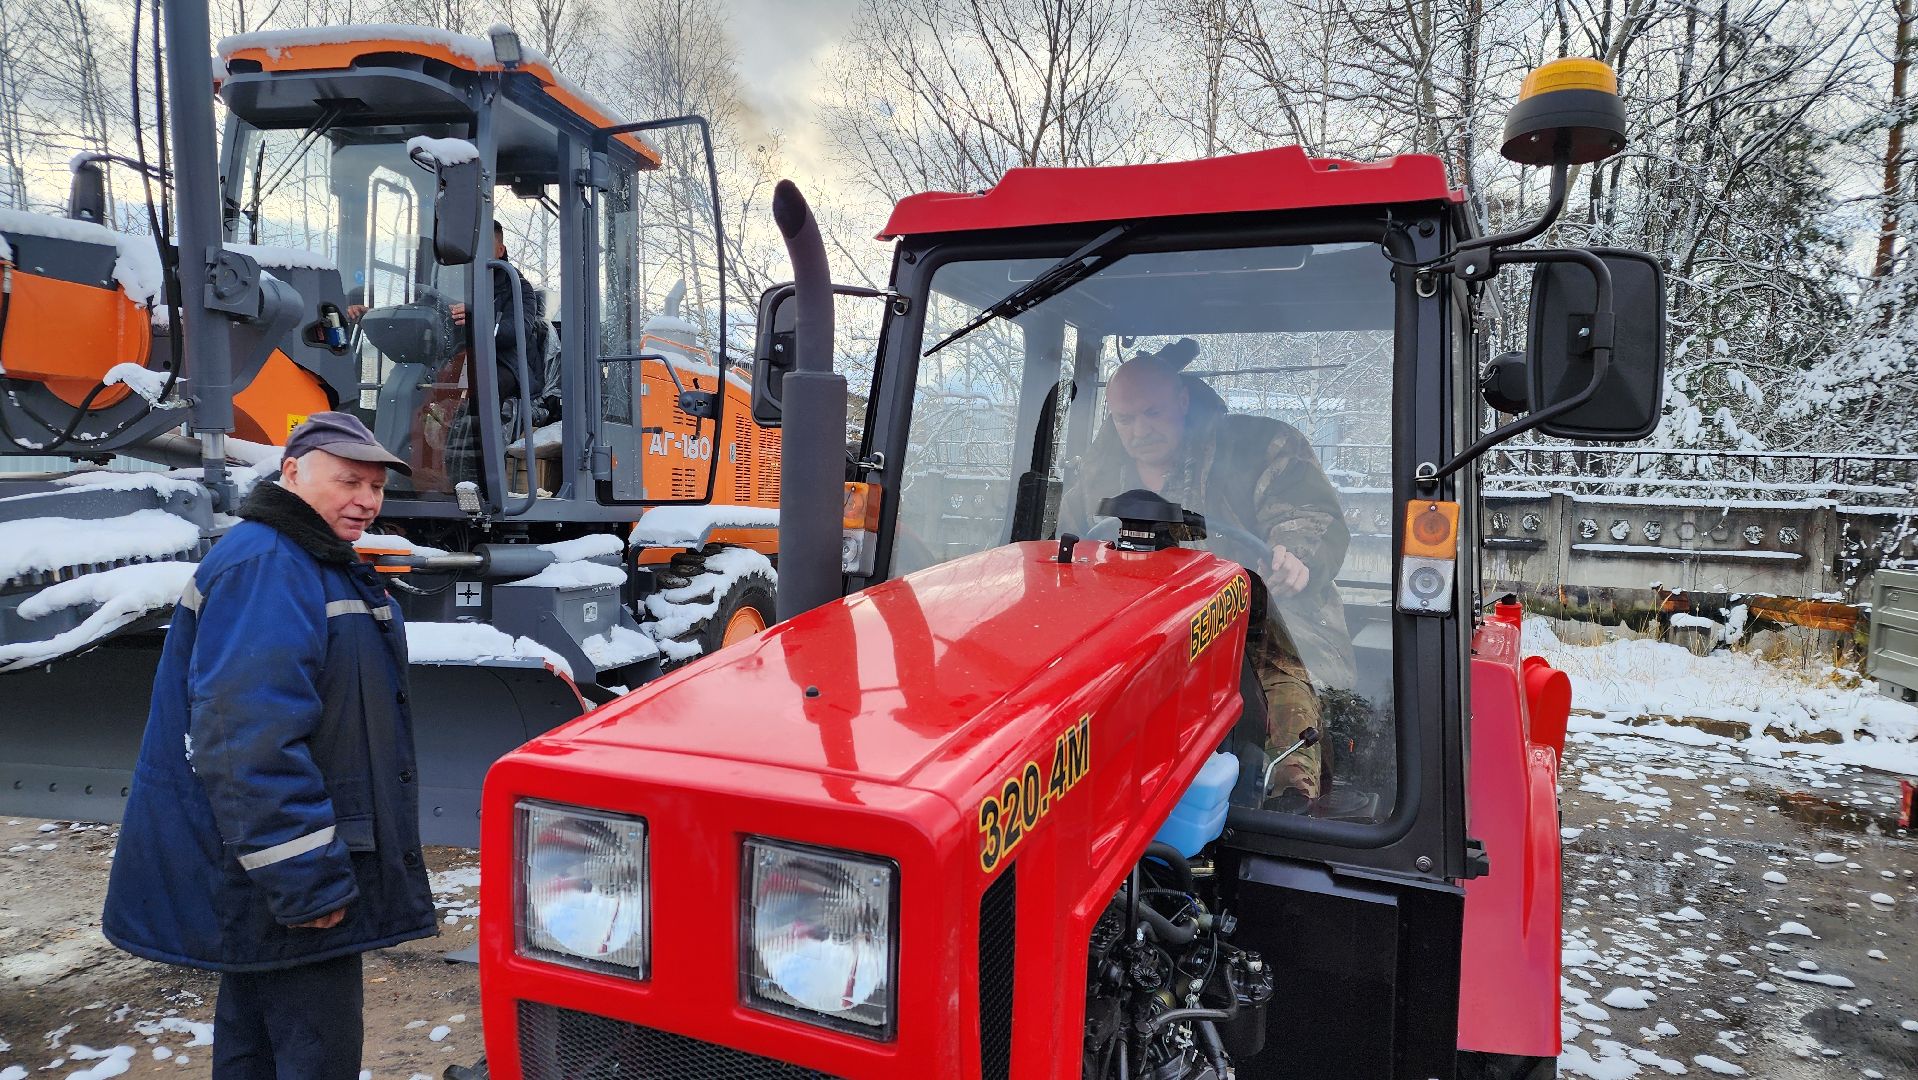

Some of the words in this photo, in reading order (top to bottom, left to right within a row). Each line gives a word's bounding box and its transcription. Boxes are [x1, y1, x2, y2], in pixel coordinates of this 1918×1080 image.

[649, 432, 710, 460] АГ-180
[1190, 575, 1248, 662] БЕЛАРУС
[979, 713, 1090, 873] 320.4М
